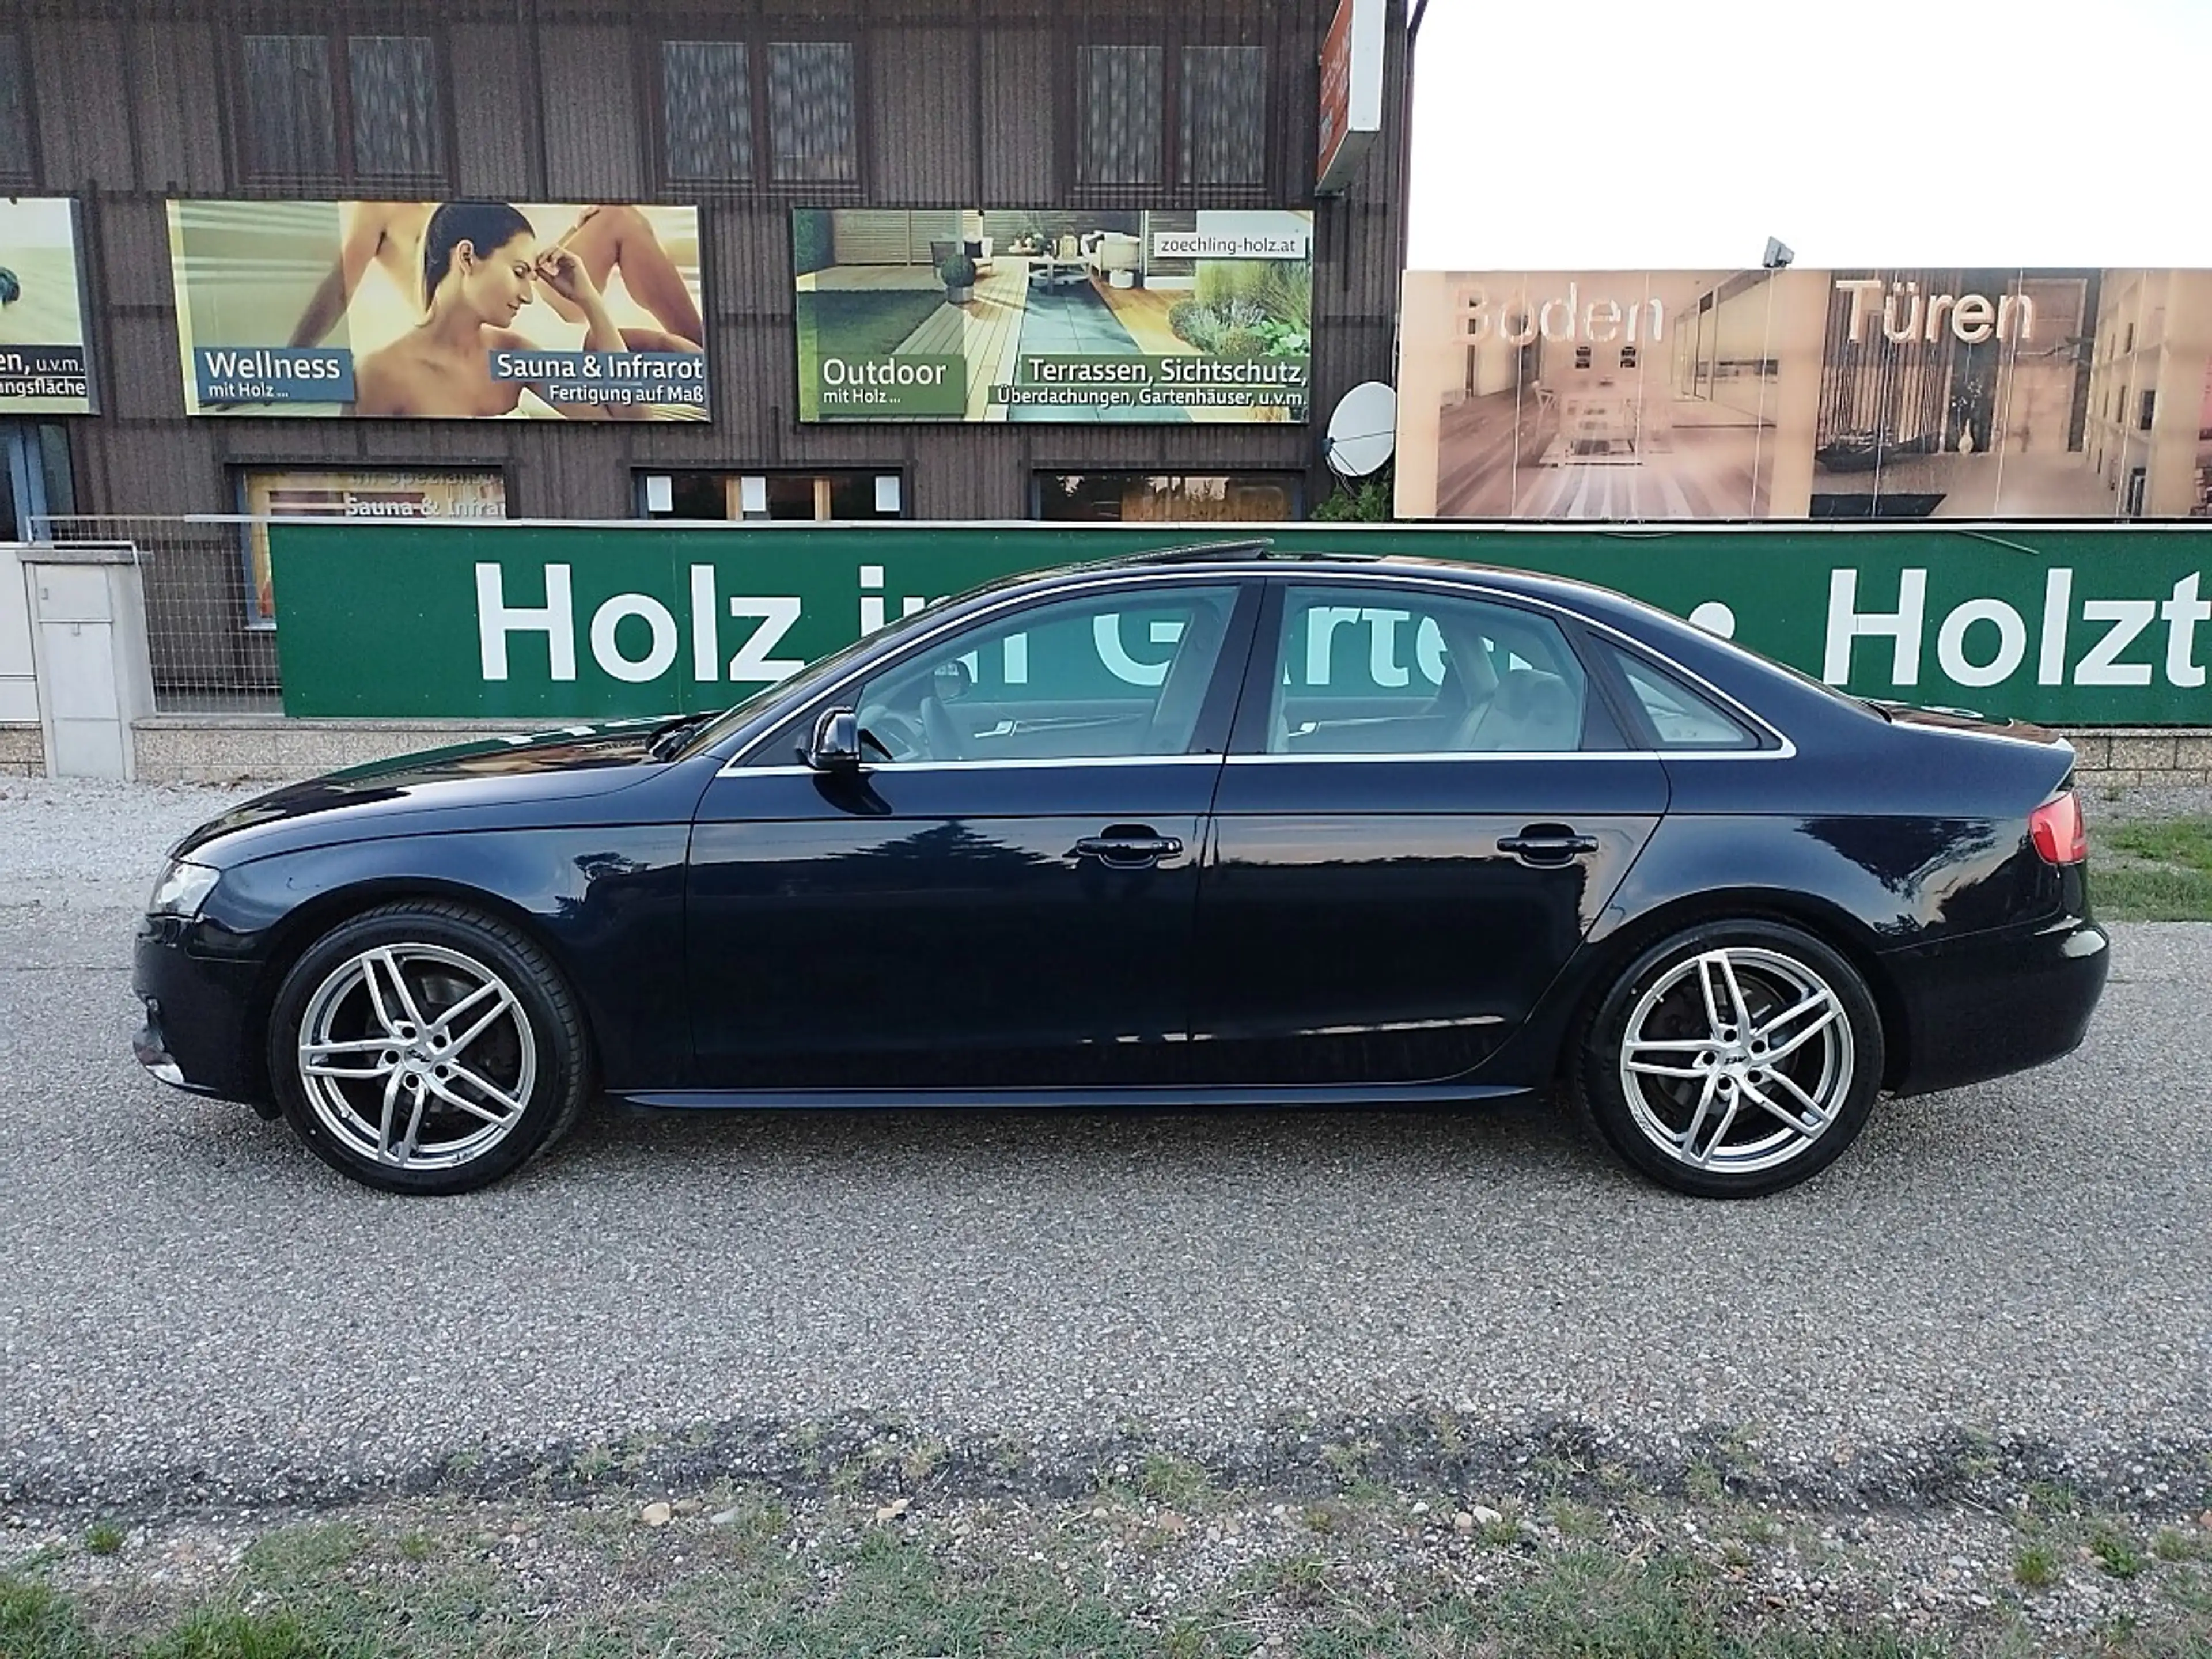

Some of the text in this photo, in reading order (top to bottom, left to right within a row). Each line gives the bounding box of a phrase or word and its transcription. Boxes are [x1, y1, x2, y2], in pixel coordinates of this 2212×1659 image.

[1160, 237, 1296, 256] zoechling-holz.at
[1451, 281, 1664, 344] Boden
[1836, 279, 2033, 344] Türen
[36, 359, 84, 372] u.v.m.
[204, 350, 340, 379] Wellness
[497, 354, 704, 380] Sauna & Infrarot
[823, 357, 947, 385] Outdoor
[1029, 358, 1308, 387] Terrassen, Sichtschutz,
[208, 382, 236, 397] mit
[550, 384, 704, 404] Fertigung auf Maß
[824, 388, 849, 403] mit
[998, 385, 1308, 408] Überdachungen, Gartenhäuser, u.v.m.
[347, 497, 414, 516] Sauna
[420, 497, 440, 516] &
[474, 562, 806, 683] Holz
[1823, 567, 2211, 688] Holzt
